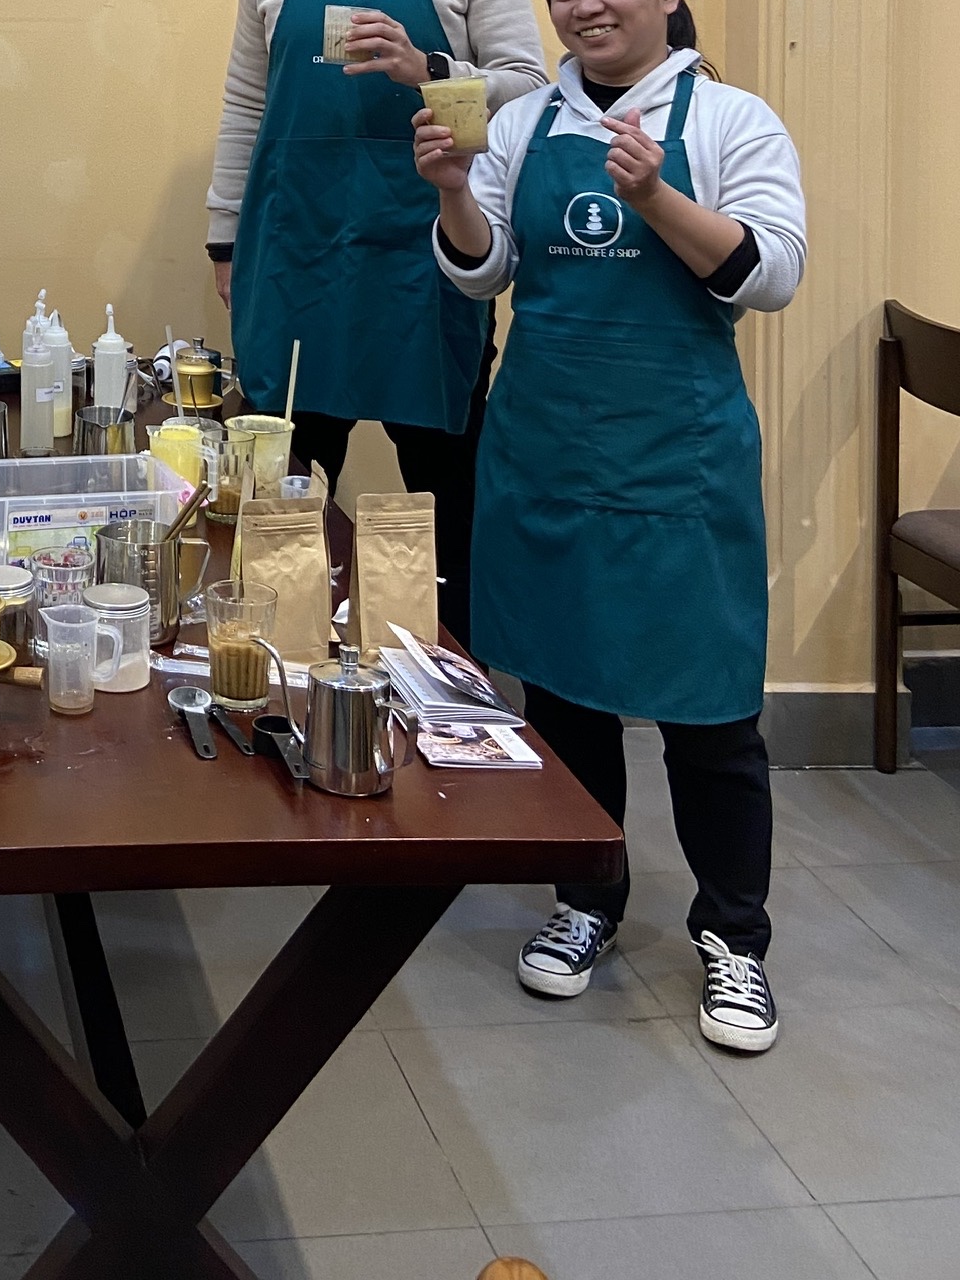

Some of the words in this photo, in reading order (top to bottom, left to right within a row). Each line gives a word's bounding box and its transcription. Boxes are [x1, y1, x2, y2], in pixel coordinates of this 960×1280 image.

[312, 55, 324, 64] CA
[585, 248, 607, 257] CAFE
[608, 248, 615, 257] &
[616, 248, 641, 258] SHOP
